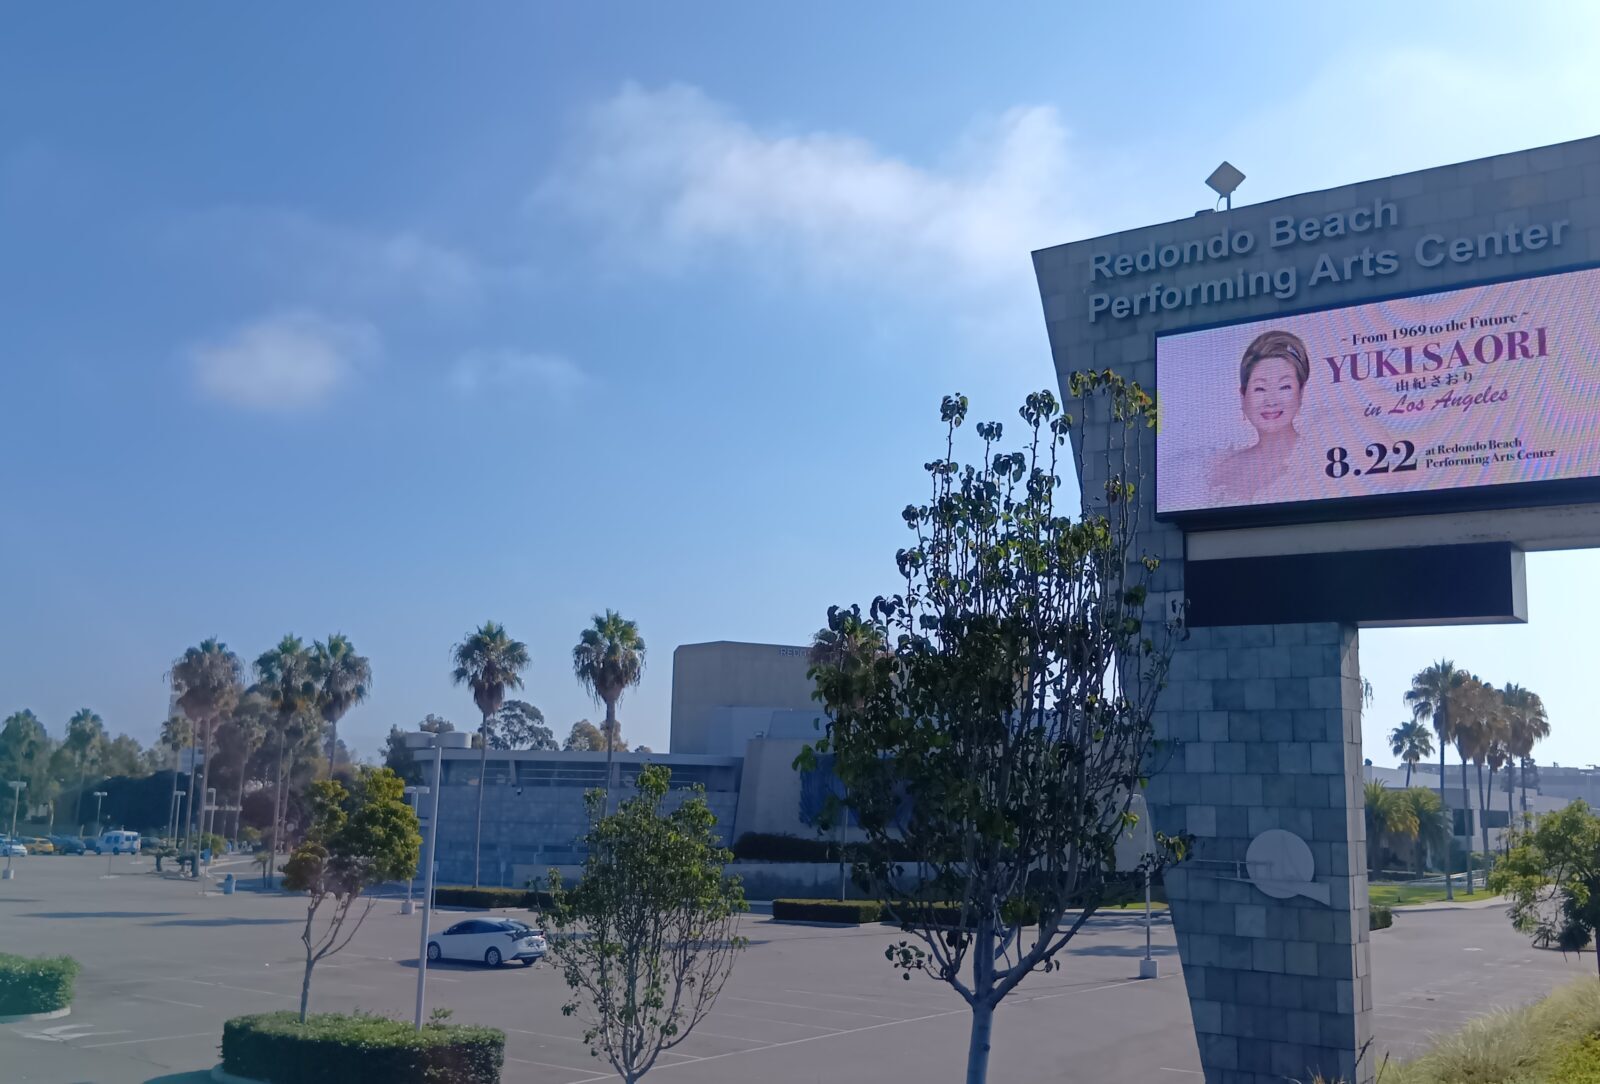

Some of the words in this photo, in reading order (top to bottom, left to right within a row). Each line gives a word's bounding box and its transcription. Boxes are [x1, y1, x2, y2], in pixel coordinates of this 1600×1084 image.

[1089, 222, 1255, 281] Redondo
[1269, 199, 1398, 248] Beach
[1088, 264, 1297, 323] Performing
[1308, 246, 1399, 287] Arts
[1415, 219, 1570, 268] Center
[1352, 333, 1388, 346] From
[1392, 325, 1426, 340] 1969
[1429, 323, 1443, 334] to
[1445, 319, 1467, 332] the
[1470, 315, 1518, 329] Future
[1364, 402, 1382, 417] in
[1388, 394, 1424, 414] Los
[1431, 386, 1508, 412] Angeles
[1325, 440, 1418, 479] 8.22
[1425, 448, 1435, 456] at
[1437, 443, 1487, 455] Redondo
[1488, 438, 1522, 449] Beach
[1426, 454, 1489, 468] Performing
[1492, 453, 1515, 462] Arts
[1517, 450, 1556, 460] Center
